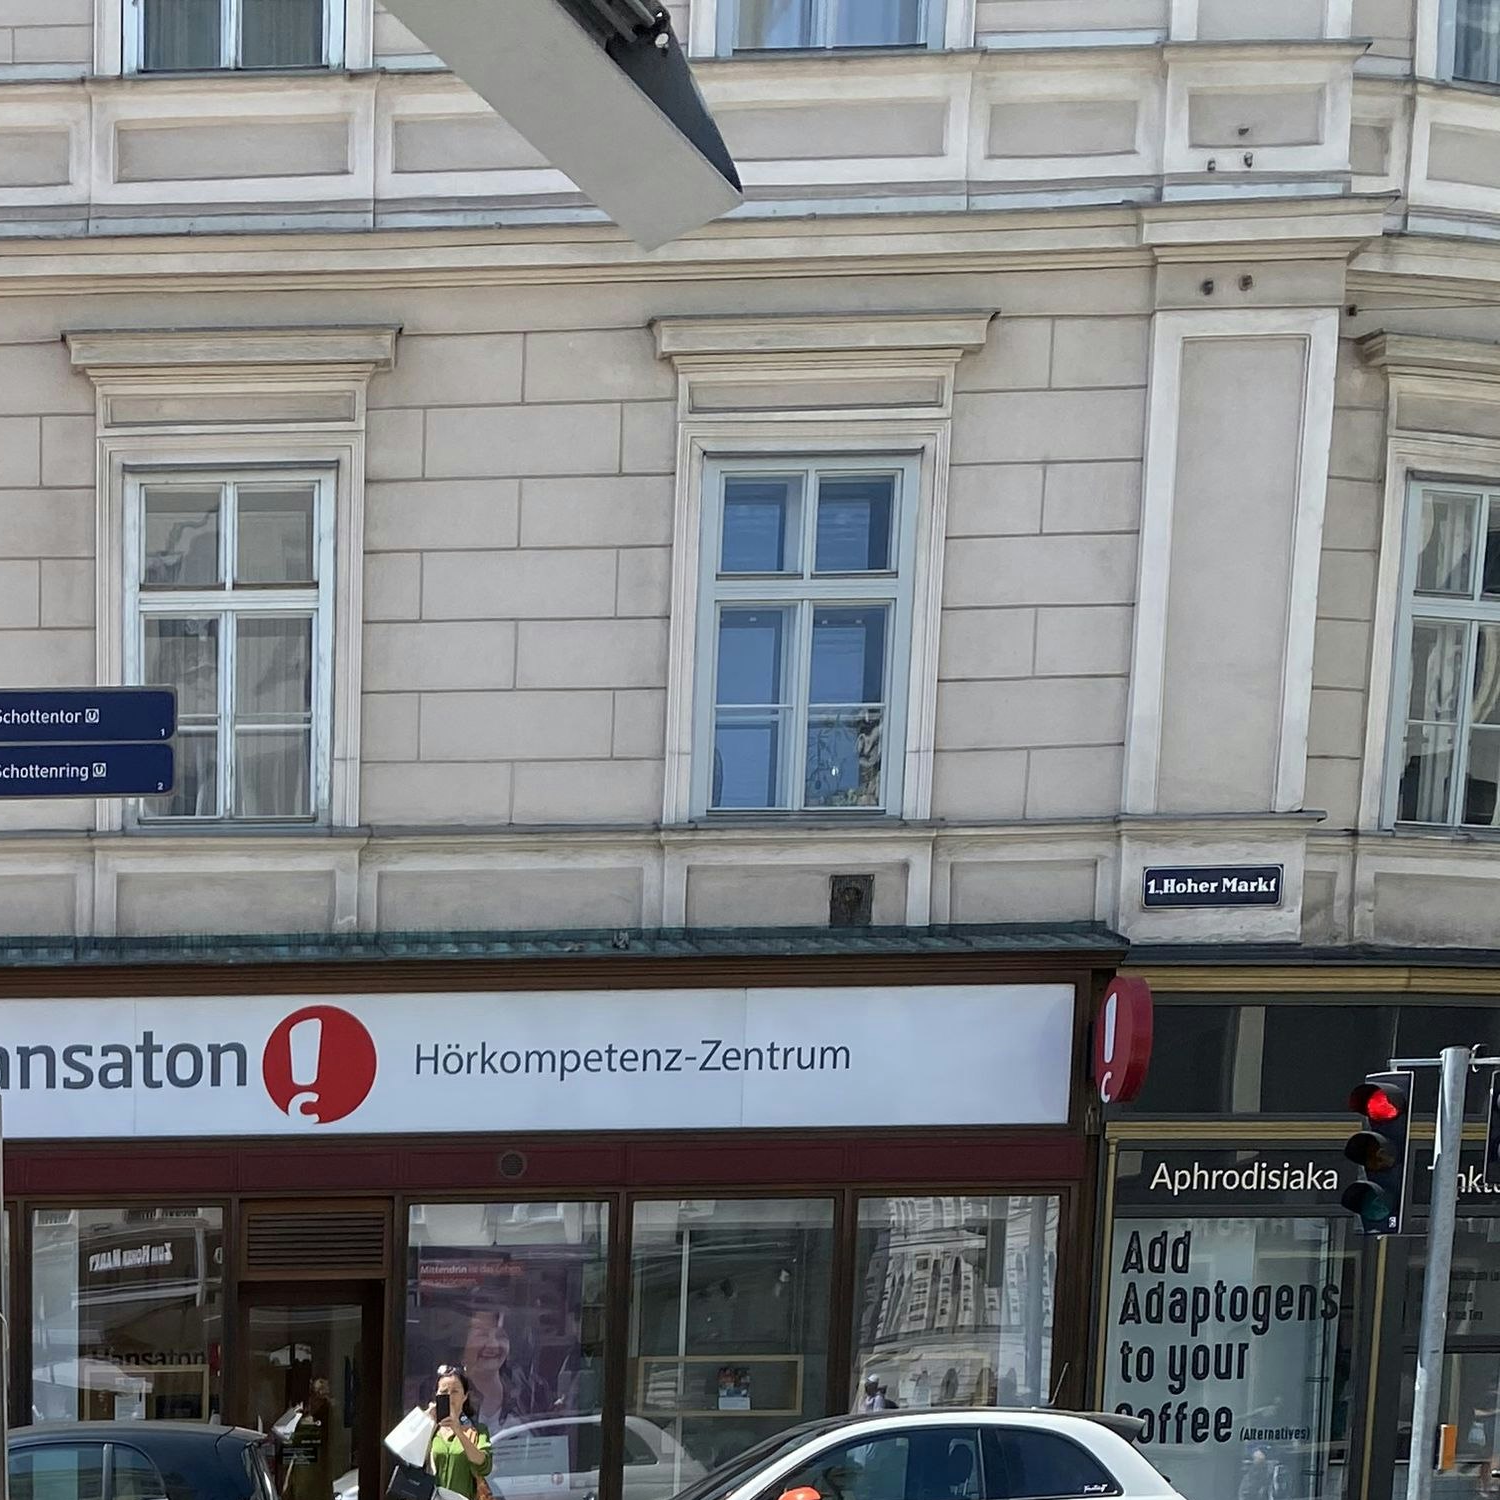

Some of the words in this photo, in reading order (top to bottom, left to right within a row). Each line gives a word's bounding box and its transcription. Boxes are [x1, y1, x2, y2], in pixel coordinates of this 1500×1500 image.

[1221, 877, 1277, 893] Markt
[414, 1039, 851, 1081] Hörkompetenz-Zentrum
[1149, 1162, 1339, 1196] Aphrodisiaka
[1121, 1231, 1191, 1274] Add
[1118, 1280, 1339, 1337] Adaptogens
[1120, 1341, 1155, 1382] to
[1168, 1342, 1249, 1395] your
